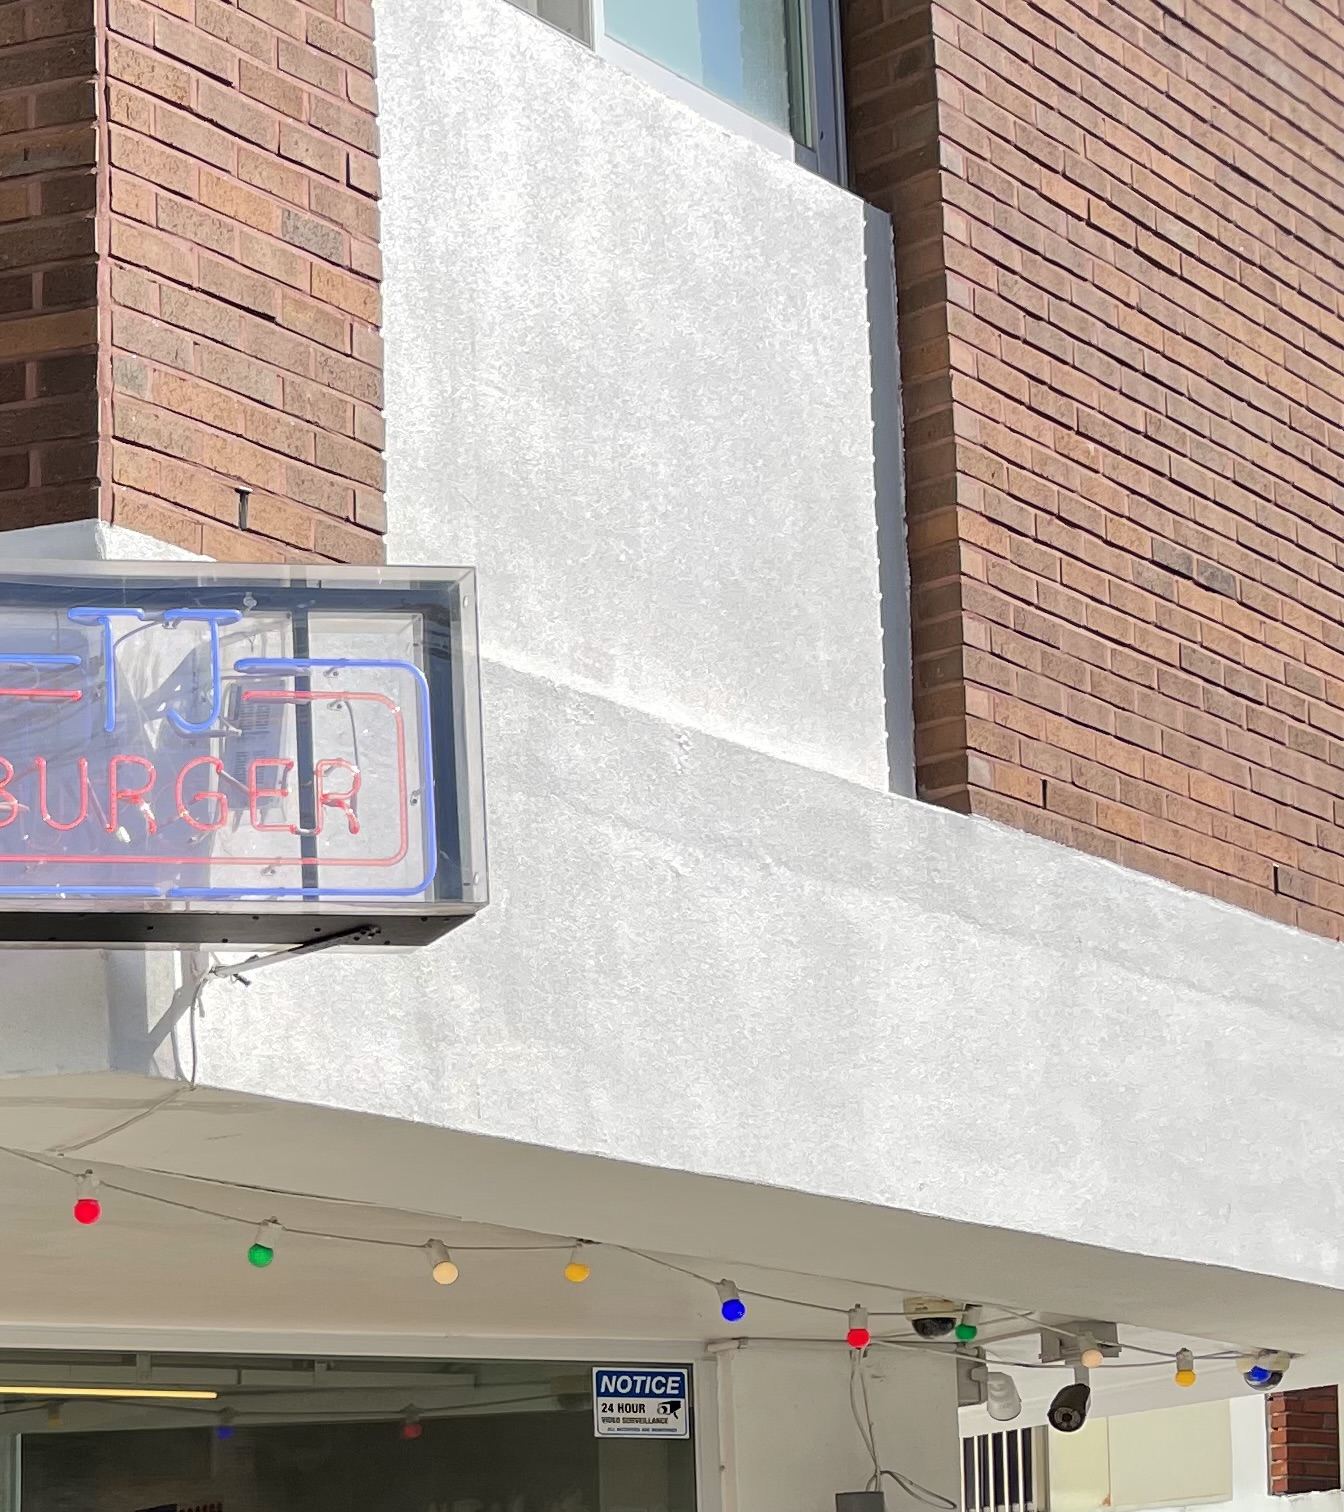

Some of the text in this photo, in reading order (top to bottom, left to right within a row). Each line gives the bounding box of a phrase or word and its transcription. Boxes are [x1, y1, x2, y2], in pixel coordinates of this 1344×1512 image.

[67, 606, 244, 733] TJ
[600, 1375, 681, 1395] NOTICE
[601, 1403, 646, 1414] 24 HOUR
